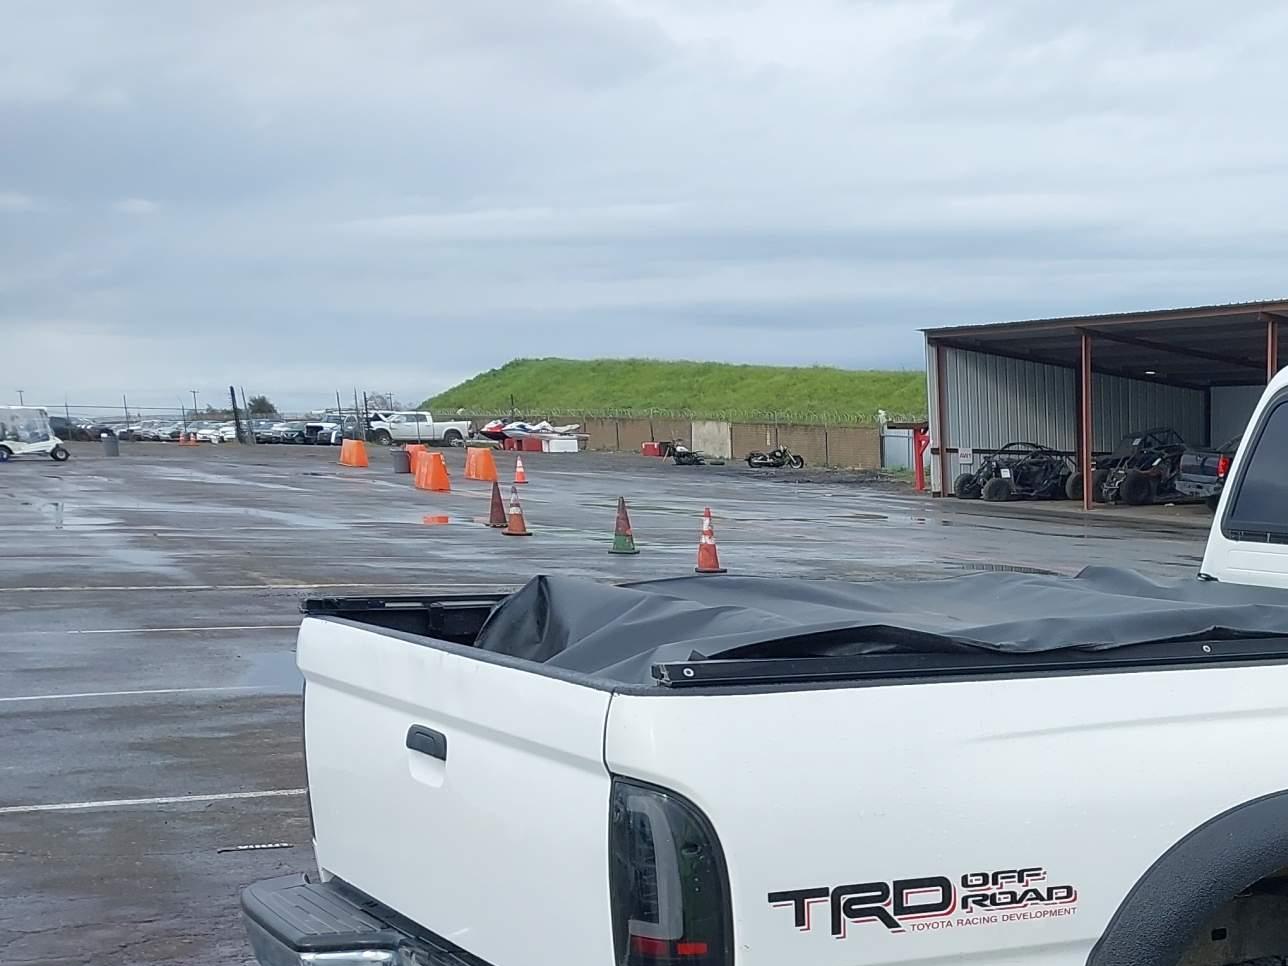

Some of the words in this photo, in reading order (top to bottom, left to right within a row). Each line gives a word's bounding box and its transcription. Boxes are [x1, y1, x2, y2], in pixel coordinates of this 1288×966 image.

[960, 866, 1047, 891] OFF
[767, 876, 956, 939] TRD
[960, 885, 1077, 914] ROAD
[910, 920, 953, 932] TOYOTA
[956, 915, 998, 928] RACING
[1001, 907, 1077, 923] DEVELOPMENT
